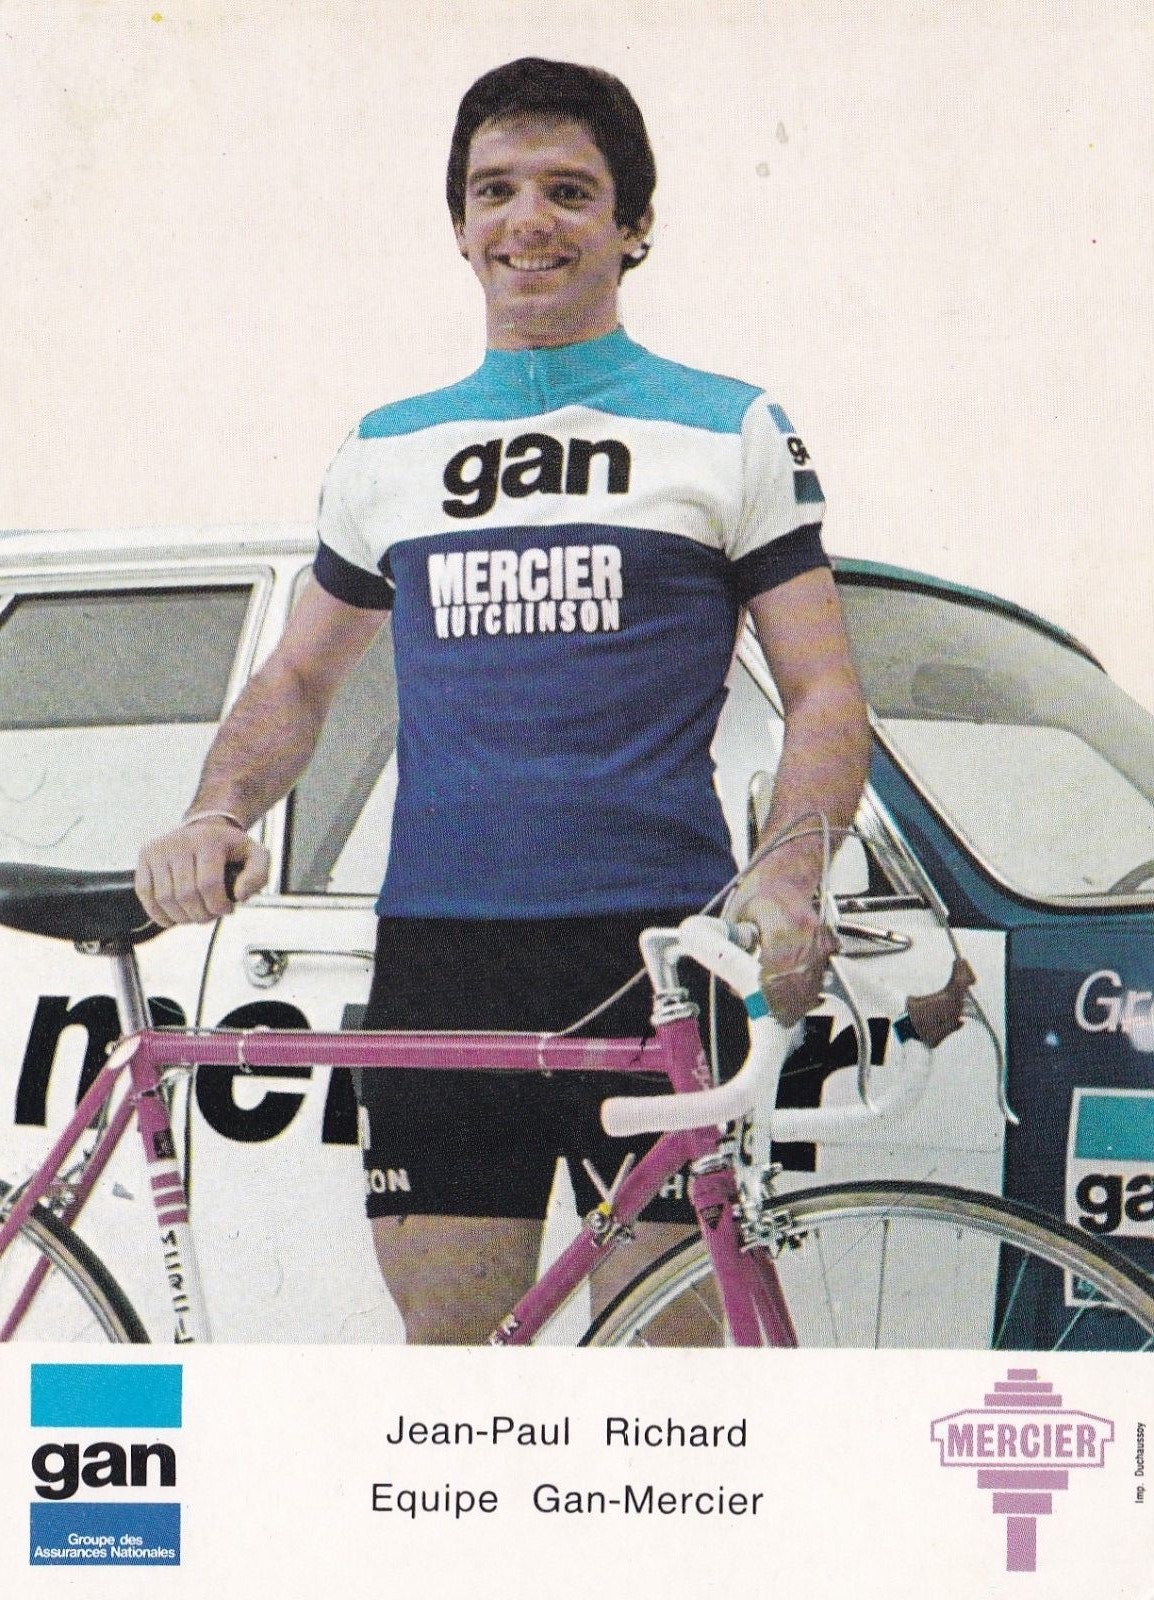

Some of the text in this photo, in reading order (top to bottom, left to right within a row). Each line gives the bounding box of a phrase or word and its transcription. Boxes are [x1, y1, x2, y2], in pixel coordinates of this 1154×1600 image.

[786, 436, 811, 467] g
[442, 432, 631, 519] gan
[427, 544, 623, 607] MERCIER
[433, 600, 620, 639] HUTCHINSON
[1075, 970, 1154, 1033] Gr
[386, 1415, 747, 1448] Jean-Paul Richard
[947, 1423, 1097, 1458] MERCIER
[1134, 1422, 1147, 1477] Duchaussoy
[31, 1441, 177, 1501] gan
[372, 1483, 765, 1520] Equipe Gan-Mercier
[33, 1545, 176, 1559] Assurances Nationales
[67, 1533, 144, 1546] Groupe des
